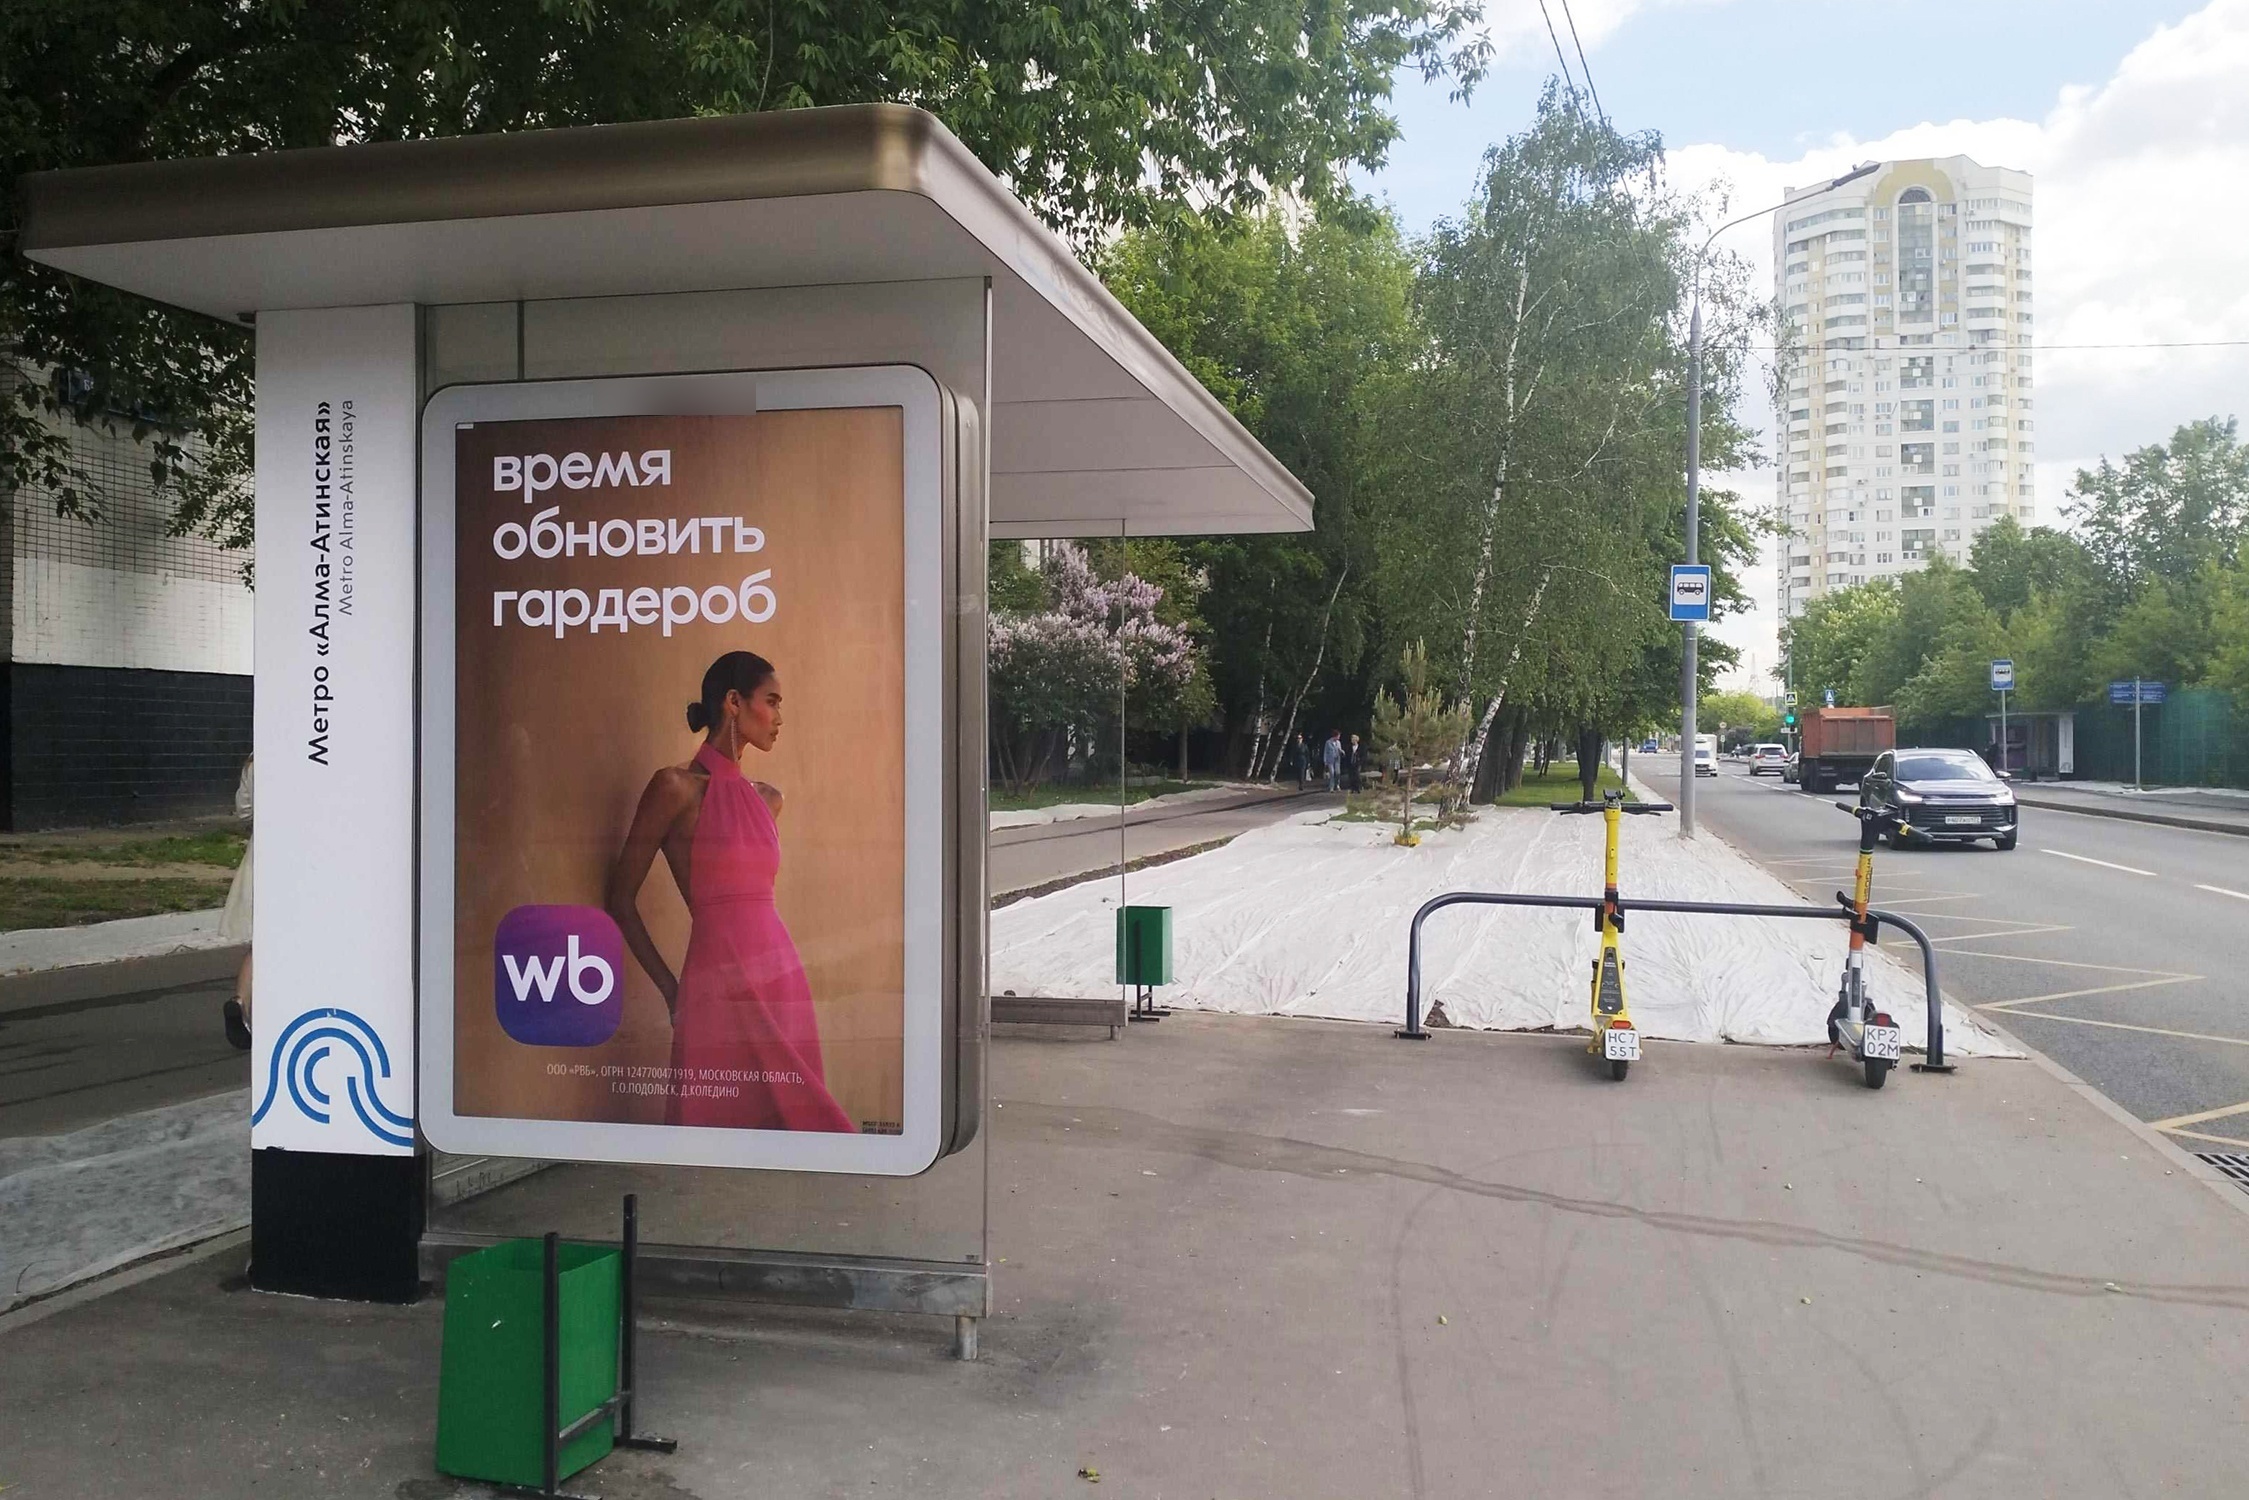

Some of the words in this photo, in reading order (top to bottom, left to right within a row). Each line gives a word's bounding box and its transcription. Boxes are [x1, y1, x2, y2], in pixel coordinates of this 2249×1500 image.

[339, 399, 358, 550] Alma-Atinskaya
[493, 449, 671, 504] время
[309, 401, 332, 657] «Алма-Атинская»
[492, 506, 766, 560] обновить
[338, 555, 354, 616] Metro
[493, 569, 777, 639] гардероб
[308, 665, 334, 766] Метро
[502, 934, 614, 1005] wb
[546, 1063, 567, 1075] ООО
[568, 1064, 599, 1078] «РВБ»,
[600, 1065, 624, 1077] ОГРН
[626, 1066, 697, 1081] 1247700471919,
[698, 1068, 760, 1083] МОСКОВСКАЯ
[761, 1070, 805, 1085] ОБЛАСТЬ,
[680, 1084, 740, 1100] Д.КОЛЕДИНО
